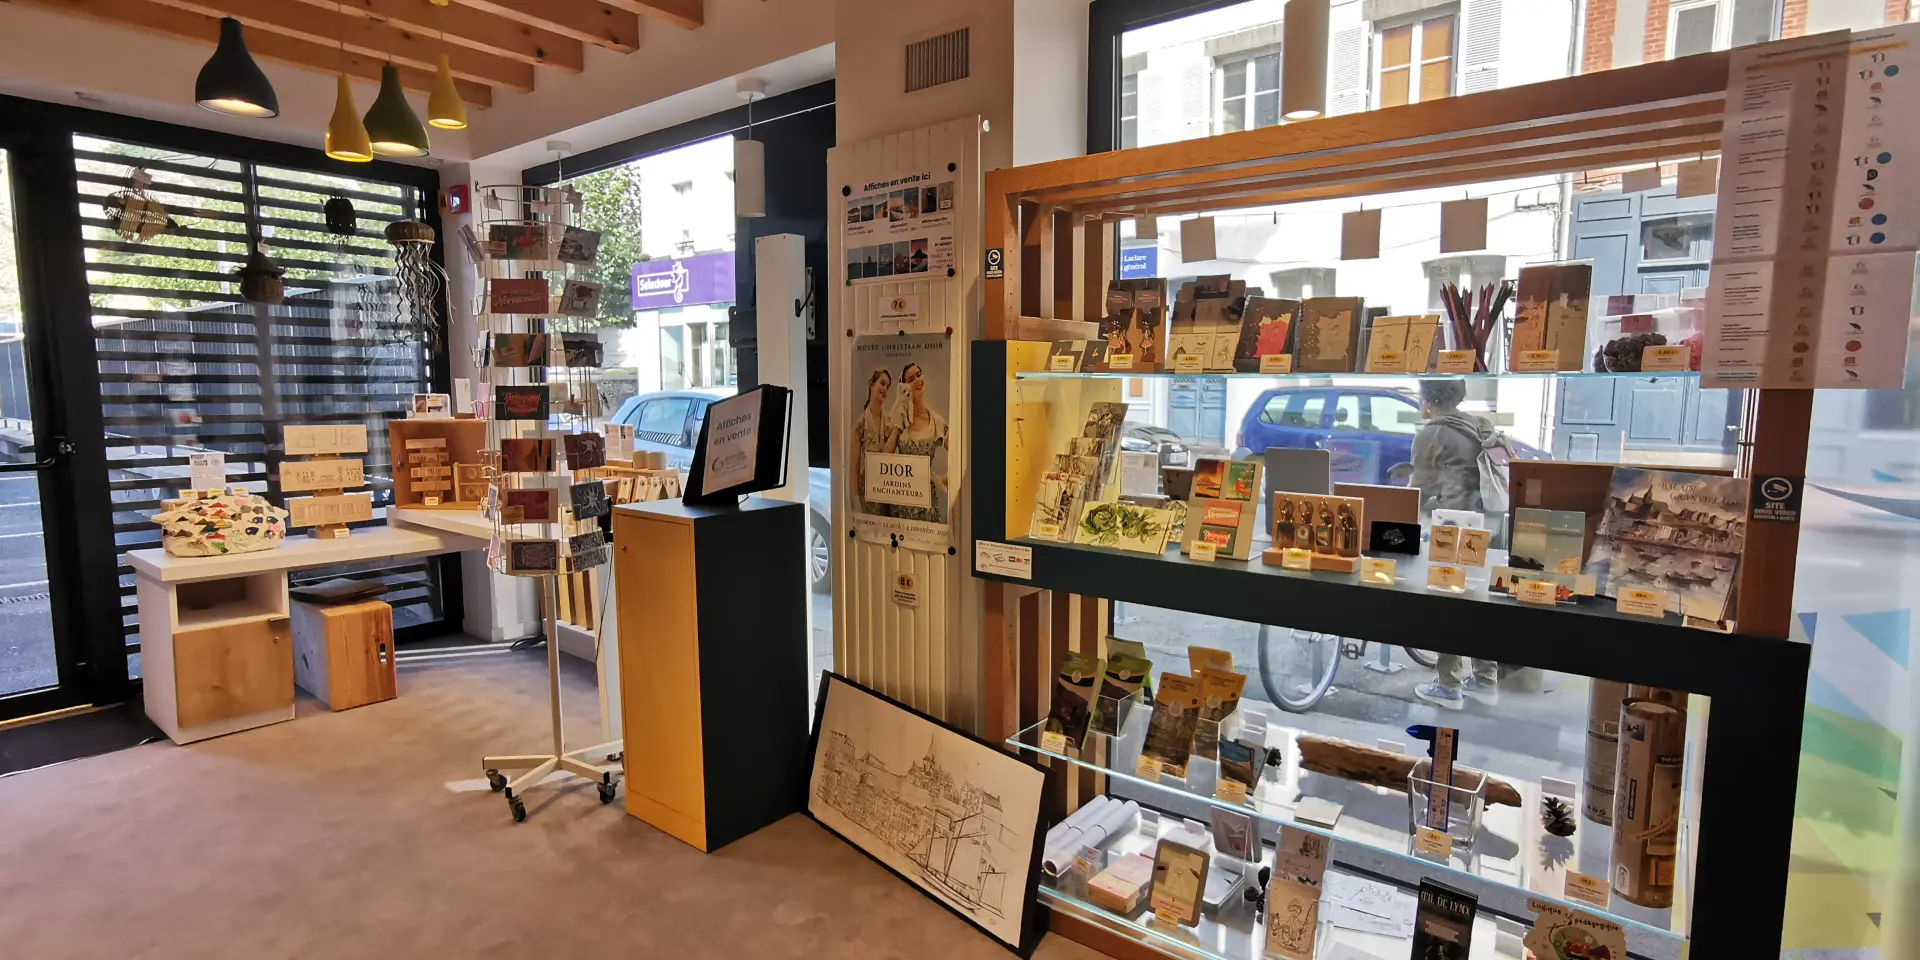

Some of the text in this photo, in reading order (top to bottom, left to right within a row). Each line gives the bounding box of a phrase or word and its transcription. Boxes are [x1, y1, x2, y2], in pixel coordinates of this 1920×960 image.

[863, 172, 931, 192] Affiches en vente ici
[716, 412, 752, 431] Affiches
[713, 427, 752, 446] en vente
[880, 462, 913, 477] DIOR
[883, 480, 912, 488] JARDINS
[872, 487, 924, 497] ENCHANTEURS
[1449, 900, 1472, 916] LYNX
[1532, 901, 1562, 915] Ludique
